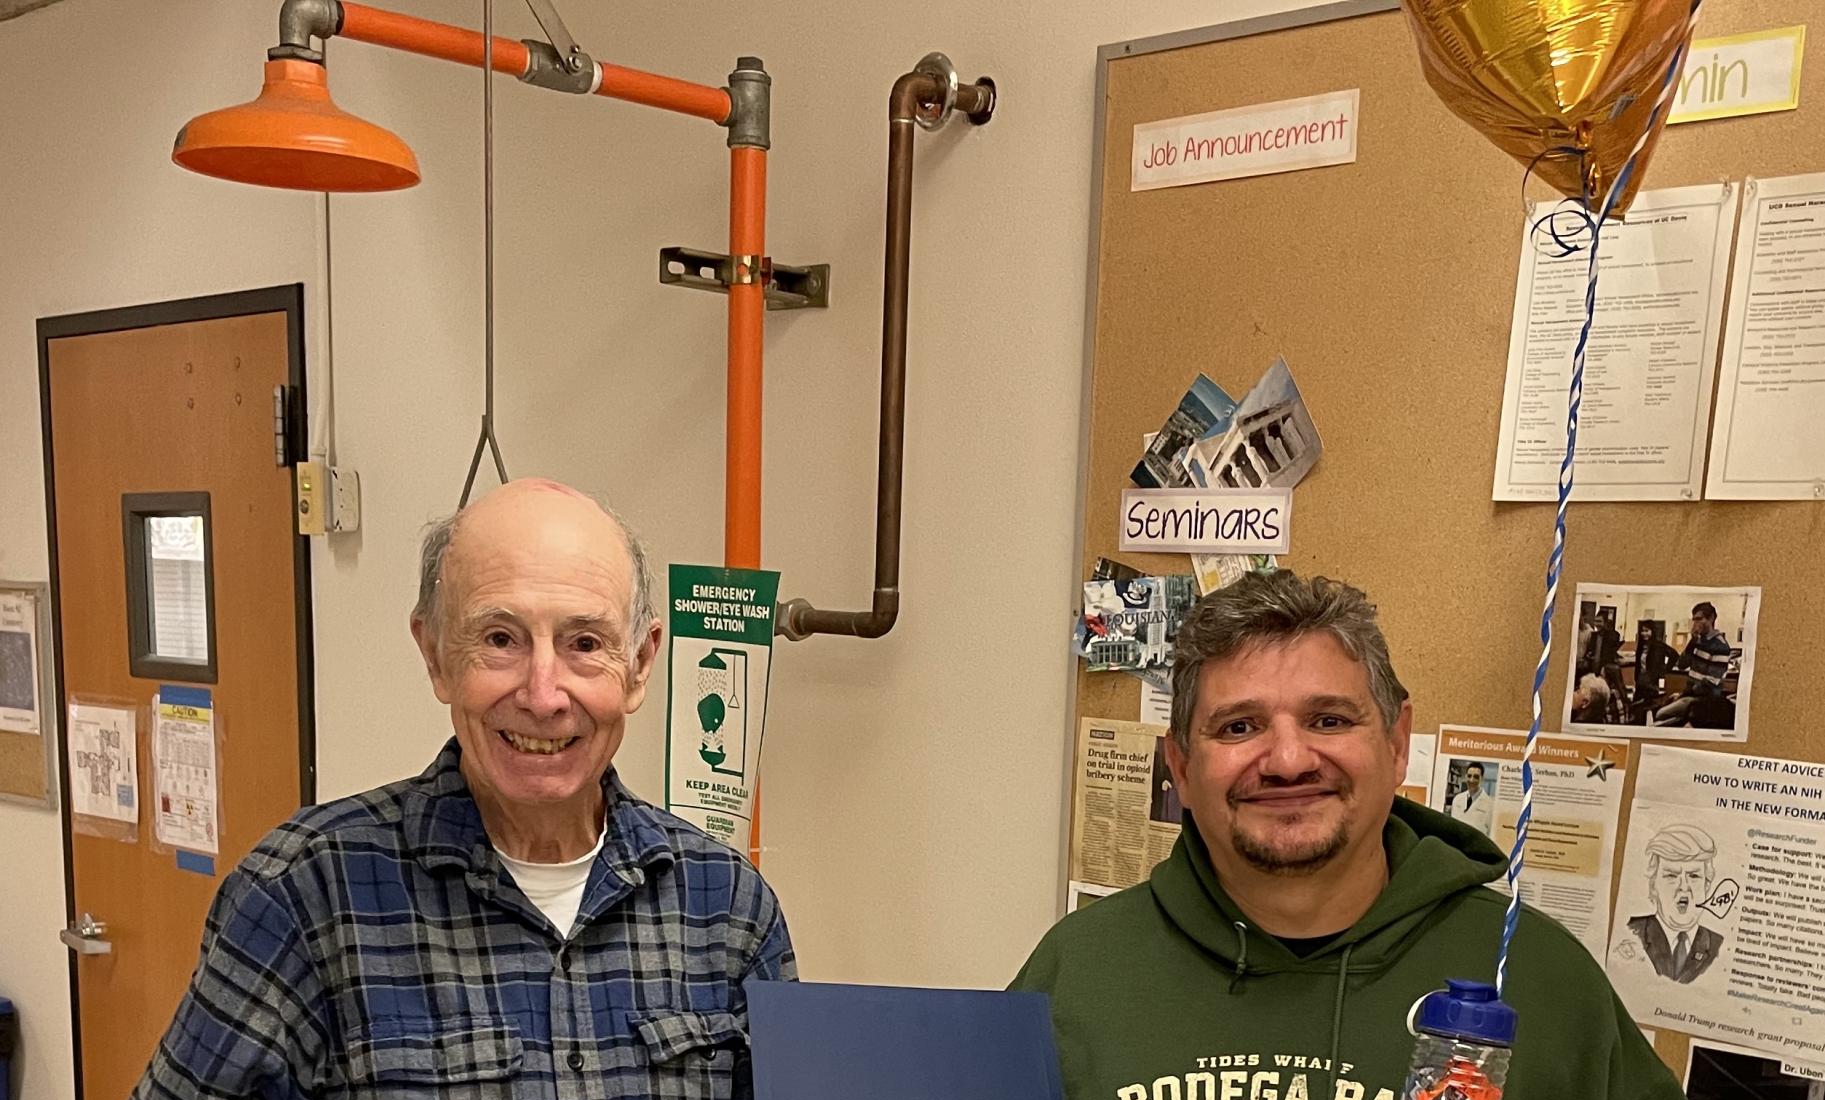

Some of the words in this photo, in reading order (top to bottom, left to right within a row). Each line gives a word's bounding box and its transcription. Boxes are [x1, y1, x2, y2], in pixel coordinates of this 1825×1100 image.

[1144, 140, 1177, 169] Job
[1184, 113, 1348, 163] Announcement
[692, 584, 756, 602] EMERGENCY
[674, 599, 741, 616] SHOWER/EYE
[742, 604, 770, 619] WASH
[703, 617, 745, 632] STATION
[1088, 748, 1109, 760] Drug
[1110, 749, 1127, 760] firm
[1129, 752, 1148, 763] chief
[1449, 737, 1504, 752] Meritorious
[1505, 742, 1537, 755] Awad
[1538, 745, 1579, 759] Winners
[1087, 760, 1097, 768] on
[1098, 760, 1116, 770] trial
[1117, 763, 1125, 772] in
[1126, 765, 1151, 775] opioid
[1737, 758, 1780, 773] EXPERT
[1781, 763, 1824, 778] ADVICE
[1086, 769, 1116, 783] bribery
[1117, 774, 1146, 785] scheme
[686, 780, 709, 790] KEEP
[711, 783, 731, 795] AREA
[1693, 773, 1722, 786] HOW
[1725, 777, 1739, 788] TO
[1742, 779, 1777, 793] WRITE
[1780, 785, 1797, 796] AN
[1801, 787, 1822, 800] NIH
[1716, 798, 1727, 808] IN
[1731, 800, 1751, 812] THE
[1753, 803, 1781, 815] NEW
[1752, 843, 1769, 851] Case
[1735, 947, 1766, 959] Research
[1731, 968, 1765, 980] Response
[1654, 1007, 1687, 1022] Donald
[1688, 1014, 1716, 1030] Trump
[1718, 1021, 1755, 1037] research
[1757, 1031, 1783, 1044] grant
[1783, 1036, 1825, 1053] proposal
[1197, 1054, 1260, 1069] TIDES
[1784, 1064, 1798, 1074] Dr.
[1799, 1067, 1823, 1079] Ubon
